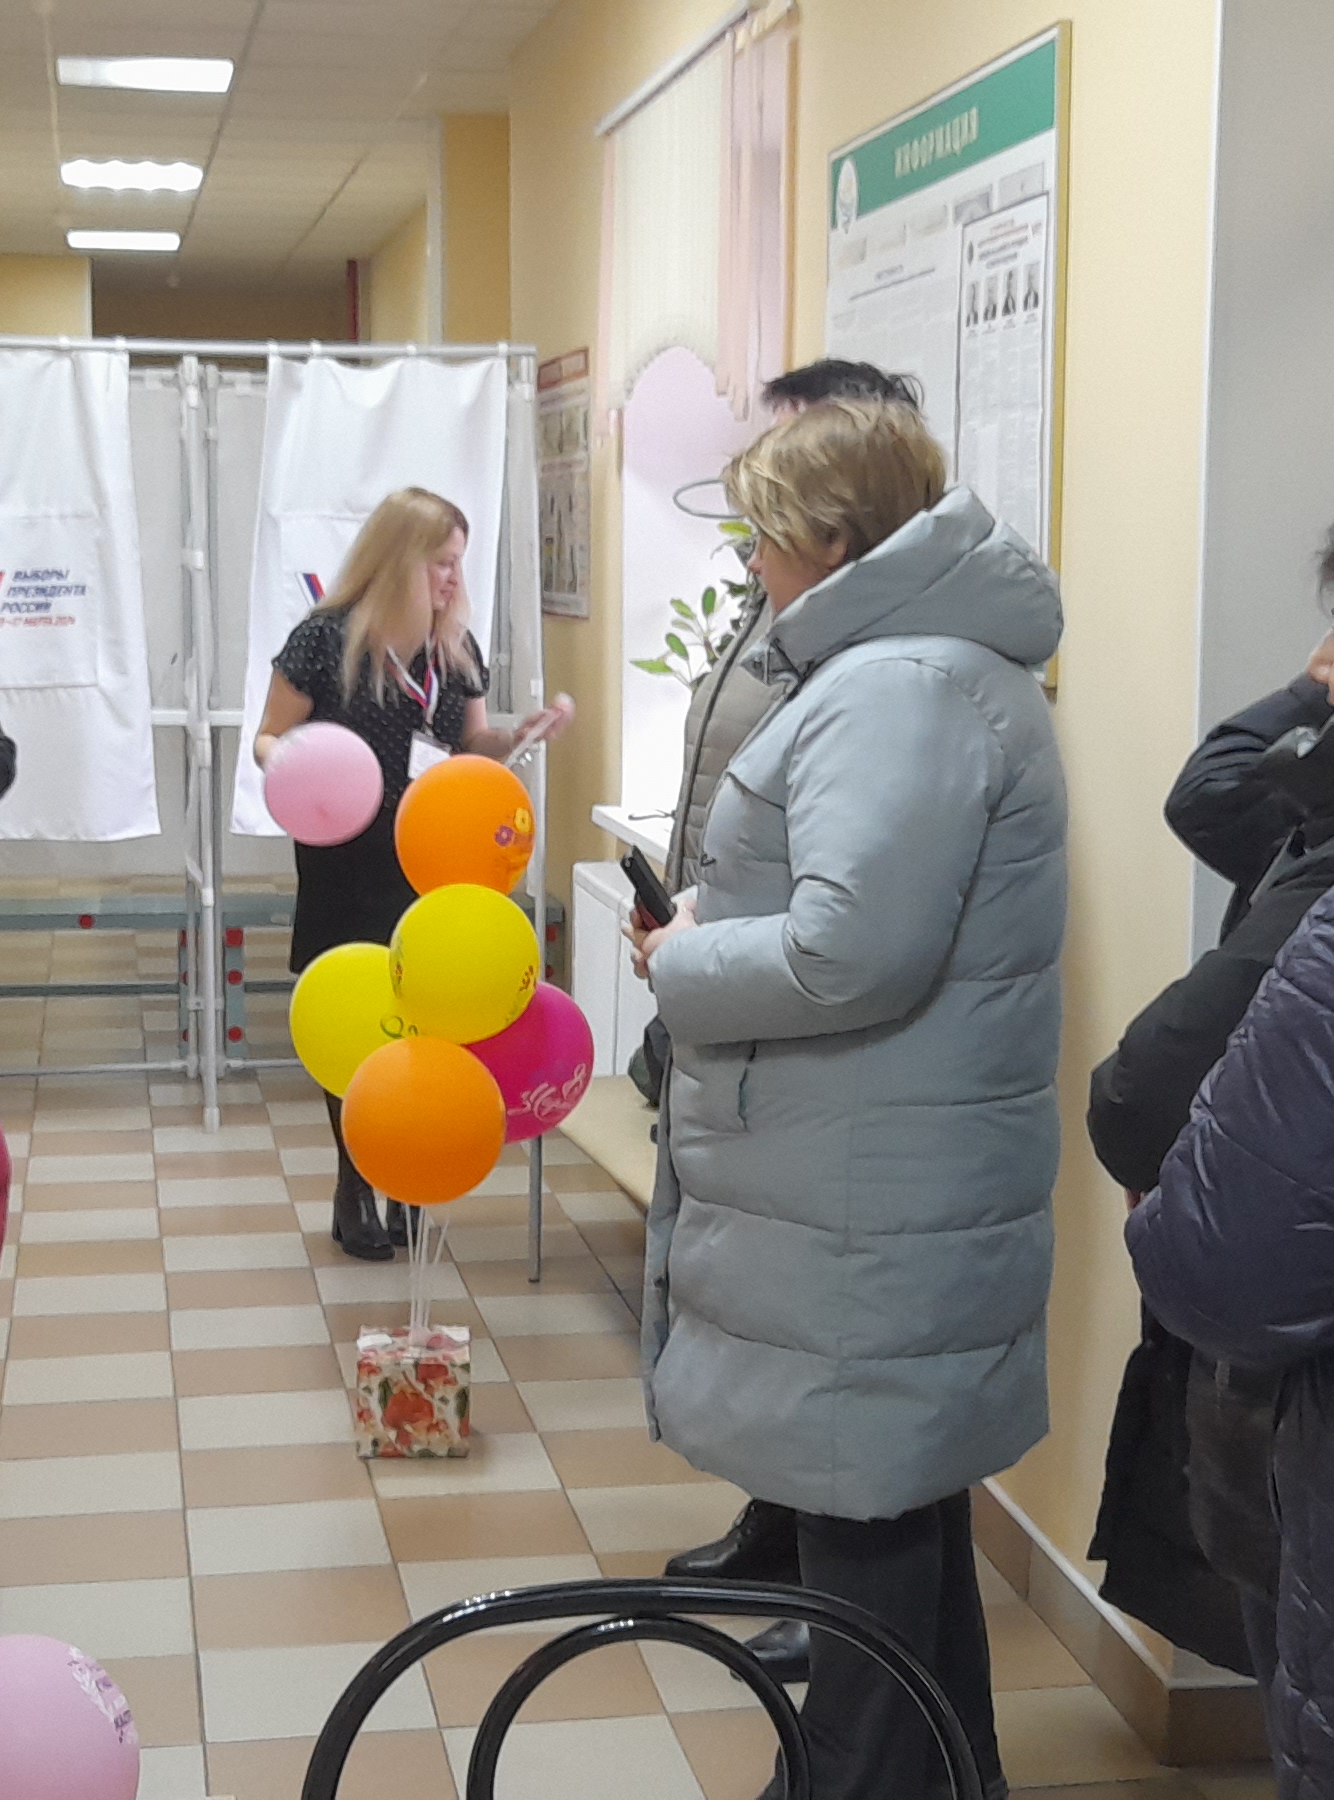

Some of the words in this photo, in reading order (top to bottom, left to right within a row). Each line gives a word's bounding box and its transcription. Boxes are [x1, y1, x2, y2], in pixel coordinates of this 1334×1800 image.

[894, 106, 979, 178] ИНФОРМАЦИЯ
[12, 568, 70, 582] ВЫБОРЫ
[6, 584, 87, 598] ПРЕЗИДЕНТА
[0, 602, 53, 614] РОССИИ
